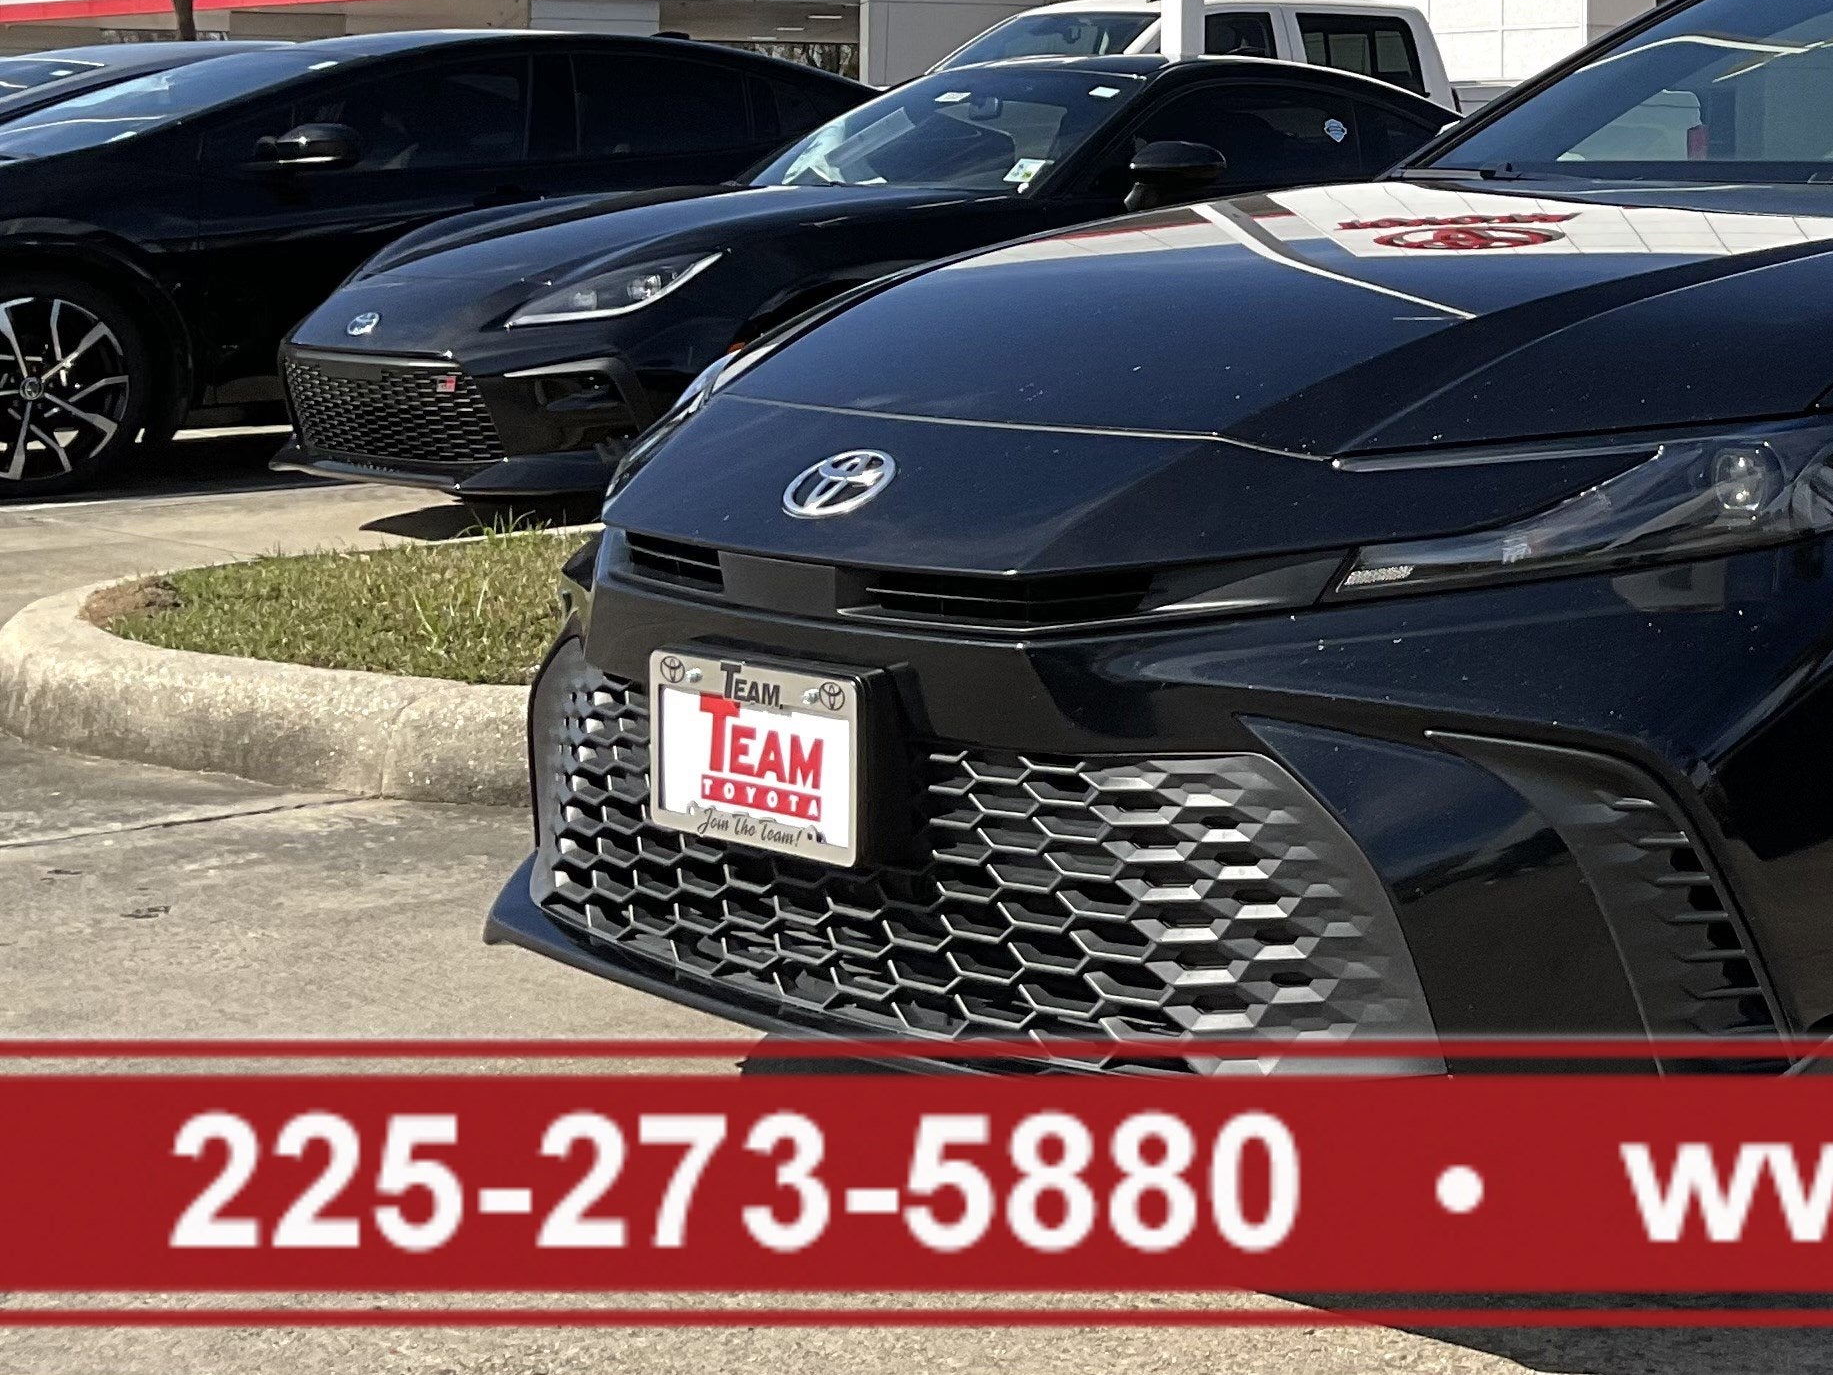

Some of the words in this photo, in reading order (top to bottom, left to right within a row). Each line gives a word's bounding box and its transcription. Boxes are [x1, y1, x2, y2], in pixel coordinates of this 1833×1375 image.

[699, 690, 824, 790] TEAM
[702, 778, 819, 818] TOYOTA
[697, 807, 730, 835] Join
[732, 812, 757, 838] The
[759, 818, 803, 848] Team!
